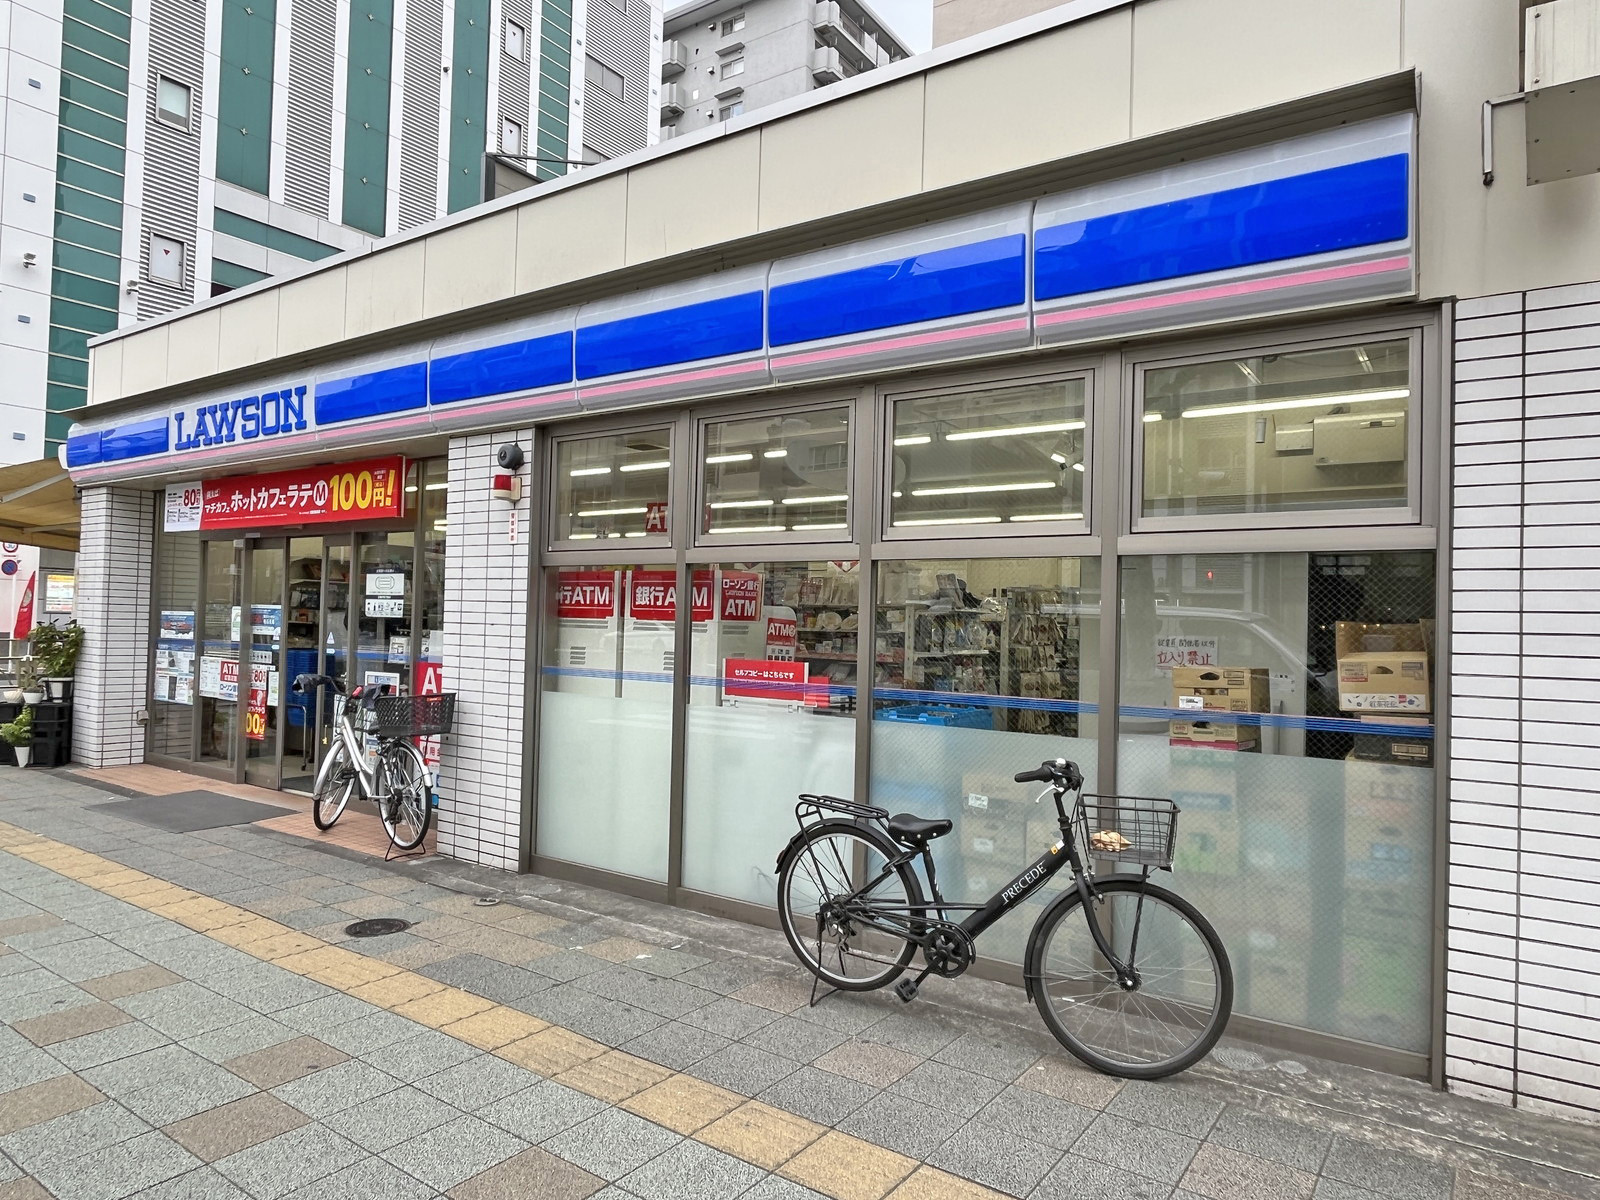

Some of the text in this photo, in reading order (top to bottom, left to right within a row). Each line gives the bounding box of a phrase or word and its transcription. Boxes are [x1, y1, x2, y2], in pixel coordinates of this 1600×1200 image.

[174, 385, 307, 451] LAWSON
[183, 488, 197, 507] 80
[204, 502, 231, 514] マチカフェ
[230, 483, 313, 512] ホットカフェラテ
[556, 586, 610, 605] 行ATM
[635, 585, 708, 607] 銀行AM
[724, 598, 756, 616] ATM
[1157, 650, 1215, 666] 立入り禁止
[1002, 861, 1047, 904] PRECEDE
